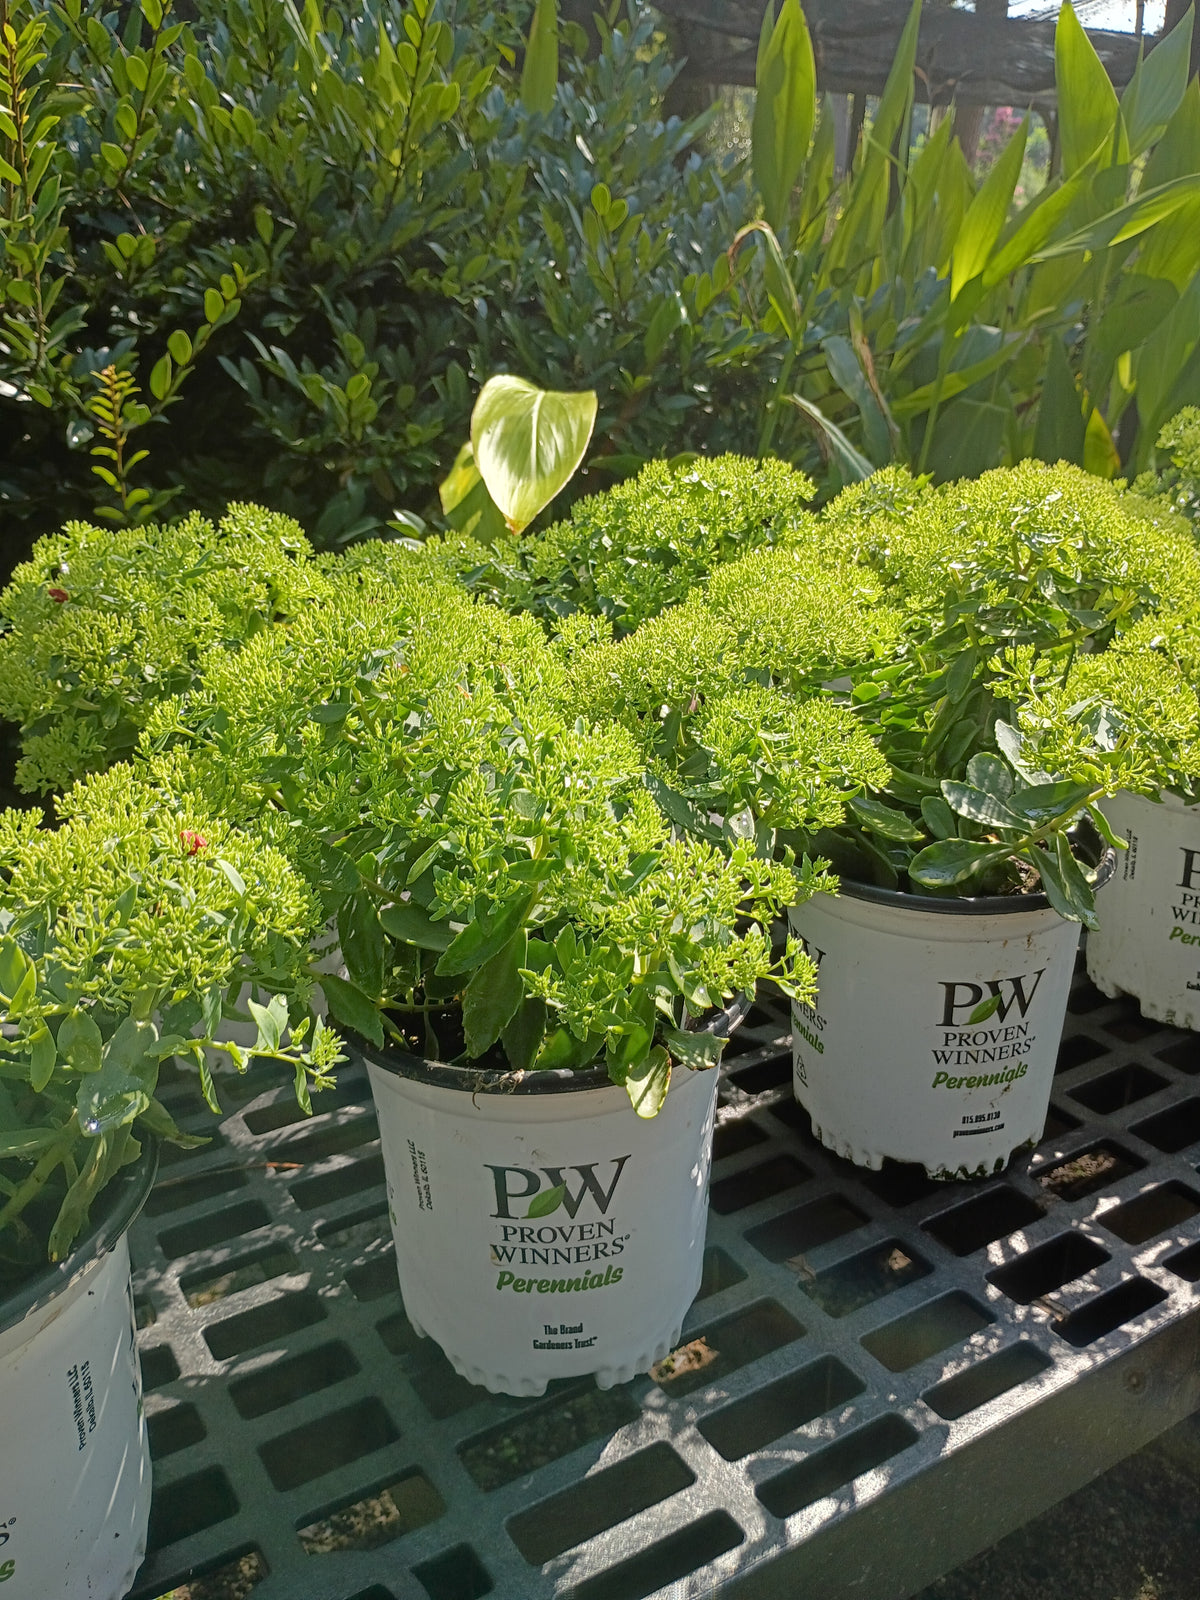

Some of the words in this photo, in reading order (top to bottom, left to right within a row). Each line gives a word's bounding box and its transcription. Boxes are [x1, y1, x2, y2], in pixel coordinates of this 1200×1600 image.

[936, 968, 1046, 1027] PW
[943, 1021, 1030, 1046] PROVEN
[931, 1061, 1028, 1089] Perennials
[483, 1154, 632, 1219] PW
[500, 1218, 616, 1244] PROVEN
[496, 1264, 624, 1293] Perennials
[543, 1324, 558, 1335] The
[560, 1322, 583, 1335] Brand
[533, 1339, 573, 1350] Gardeners
[67, 1364, 78, 1387] LLC
[81, 1360, 92, 1390] 60115
[72, 1382, 82, 1422] Winners
[78, 1417, 86, 1451] Proven
